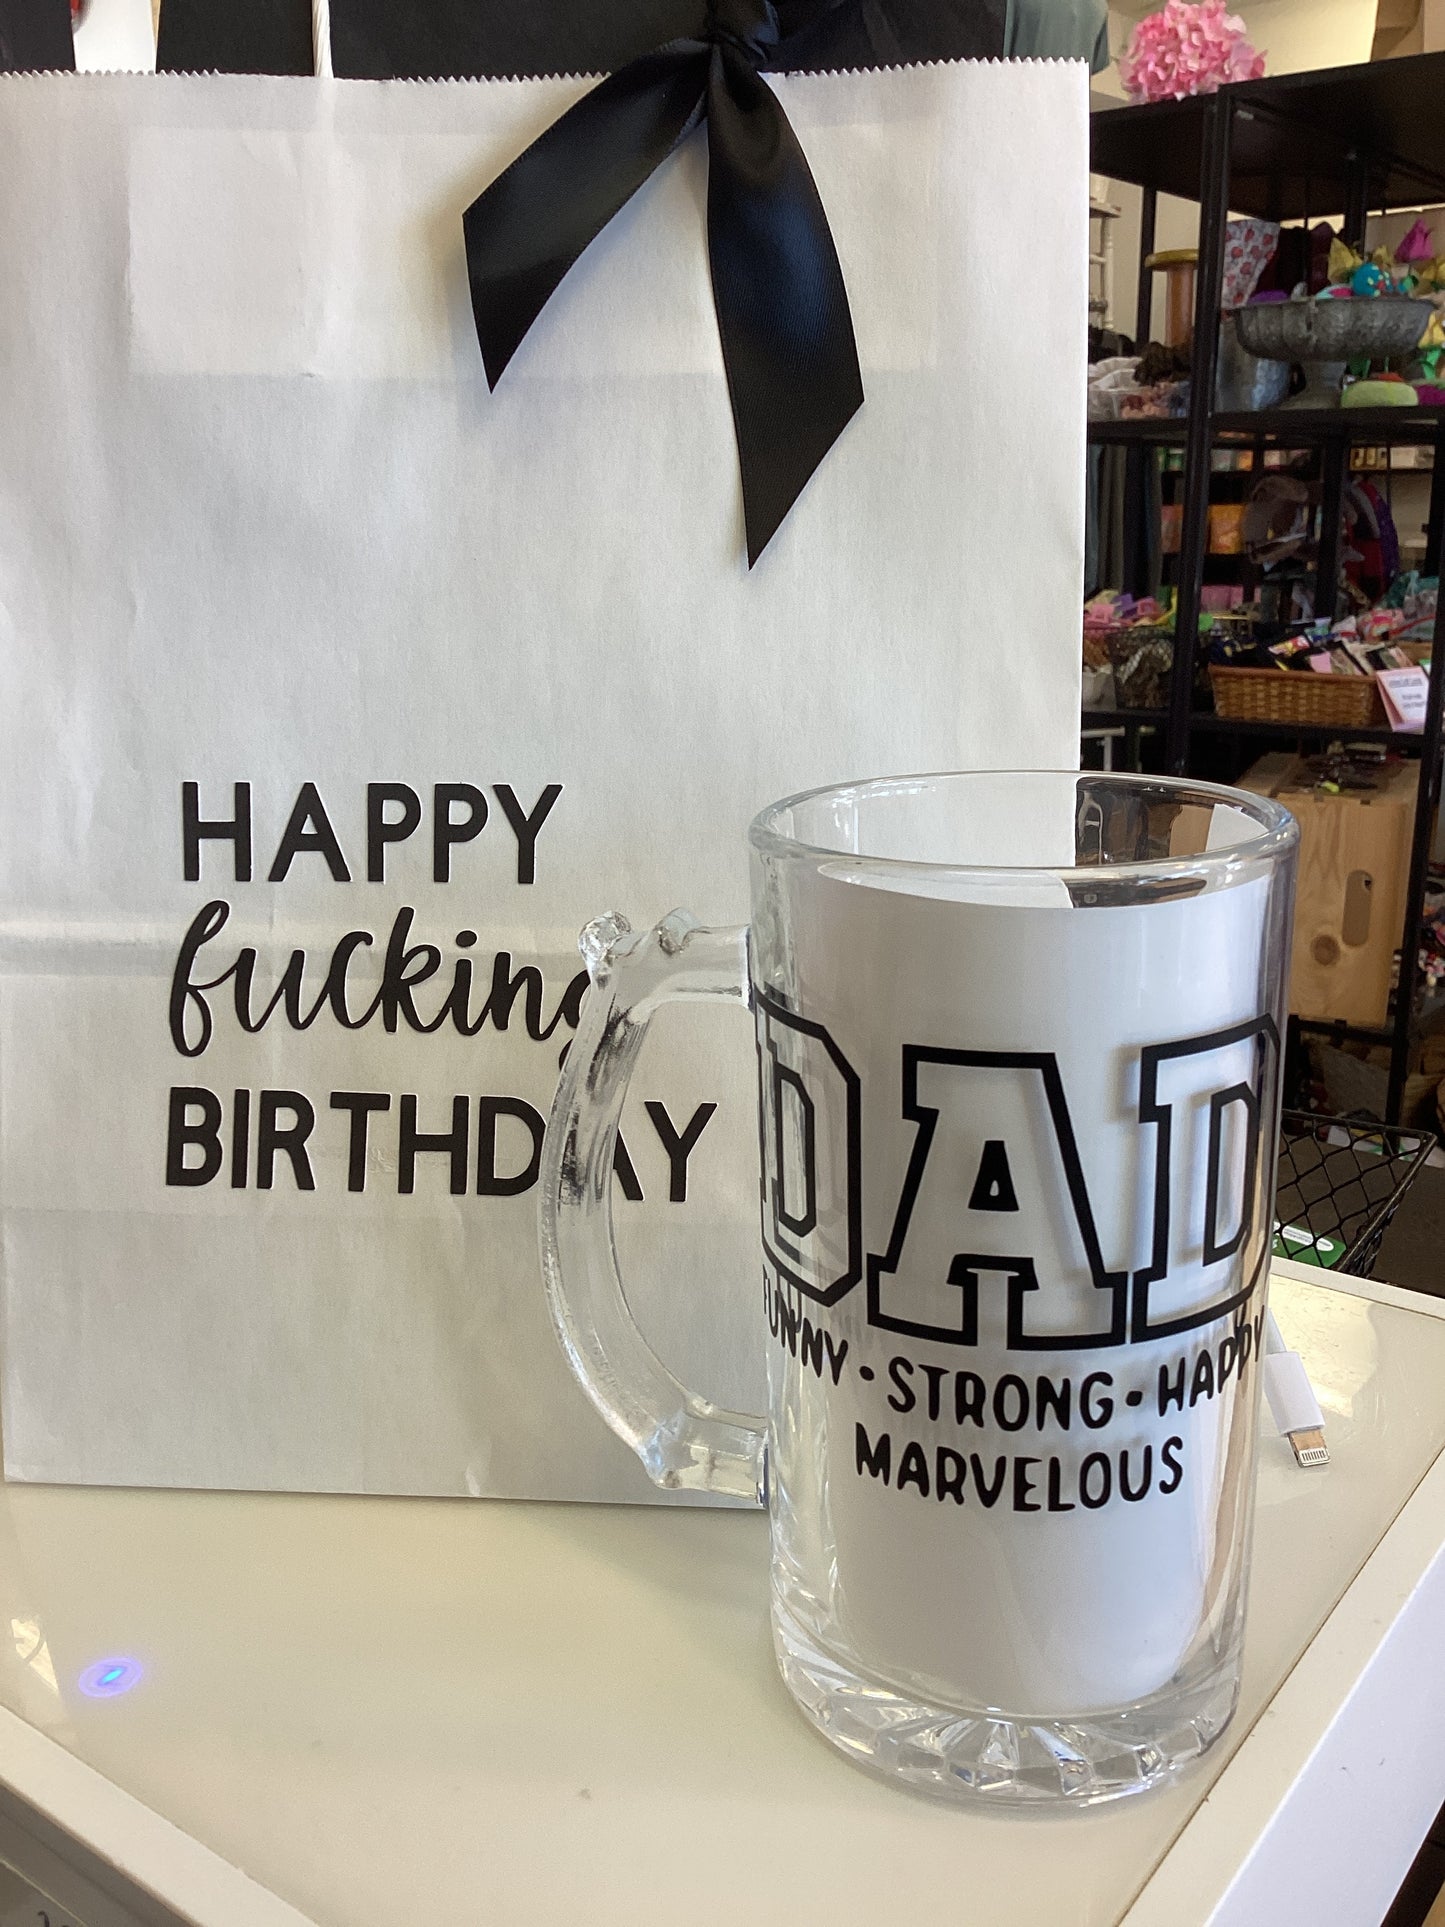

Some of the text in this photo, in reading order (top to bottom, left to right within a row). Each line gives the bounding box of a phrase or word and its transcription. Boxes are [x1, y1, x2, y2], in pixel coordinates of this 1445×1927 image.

[182, 781, 564, 885] HAPPY
[753, 982, 1282, 1351] DAD
[887, 1355, 1115, 1431] STRONG
[1157, 1304, 1265, 1417] HAPPY
[854, 1422, 1184, 1512] MARVELOUS
